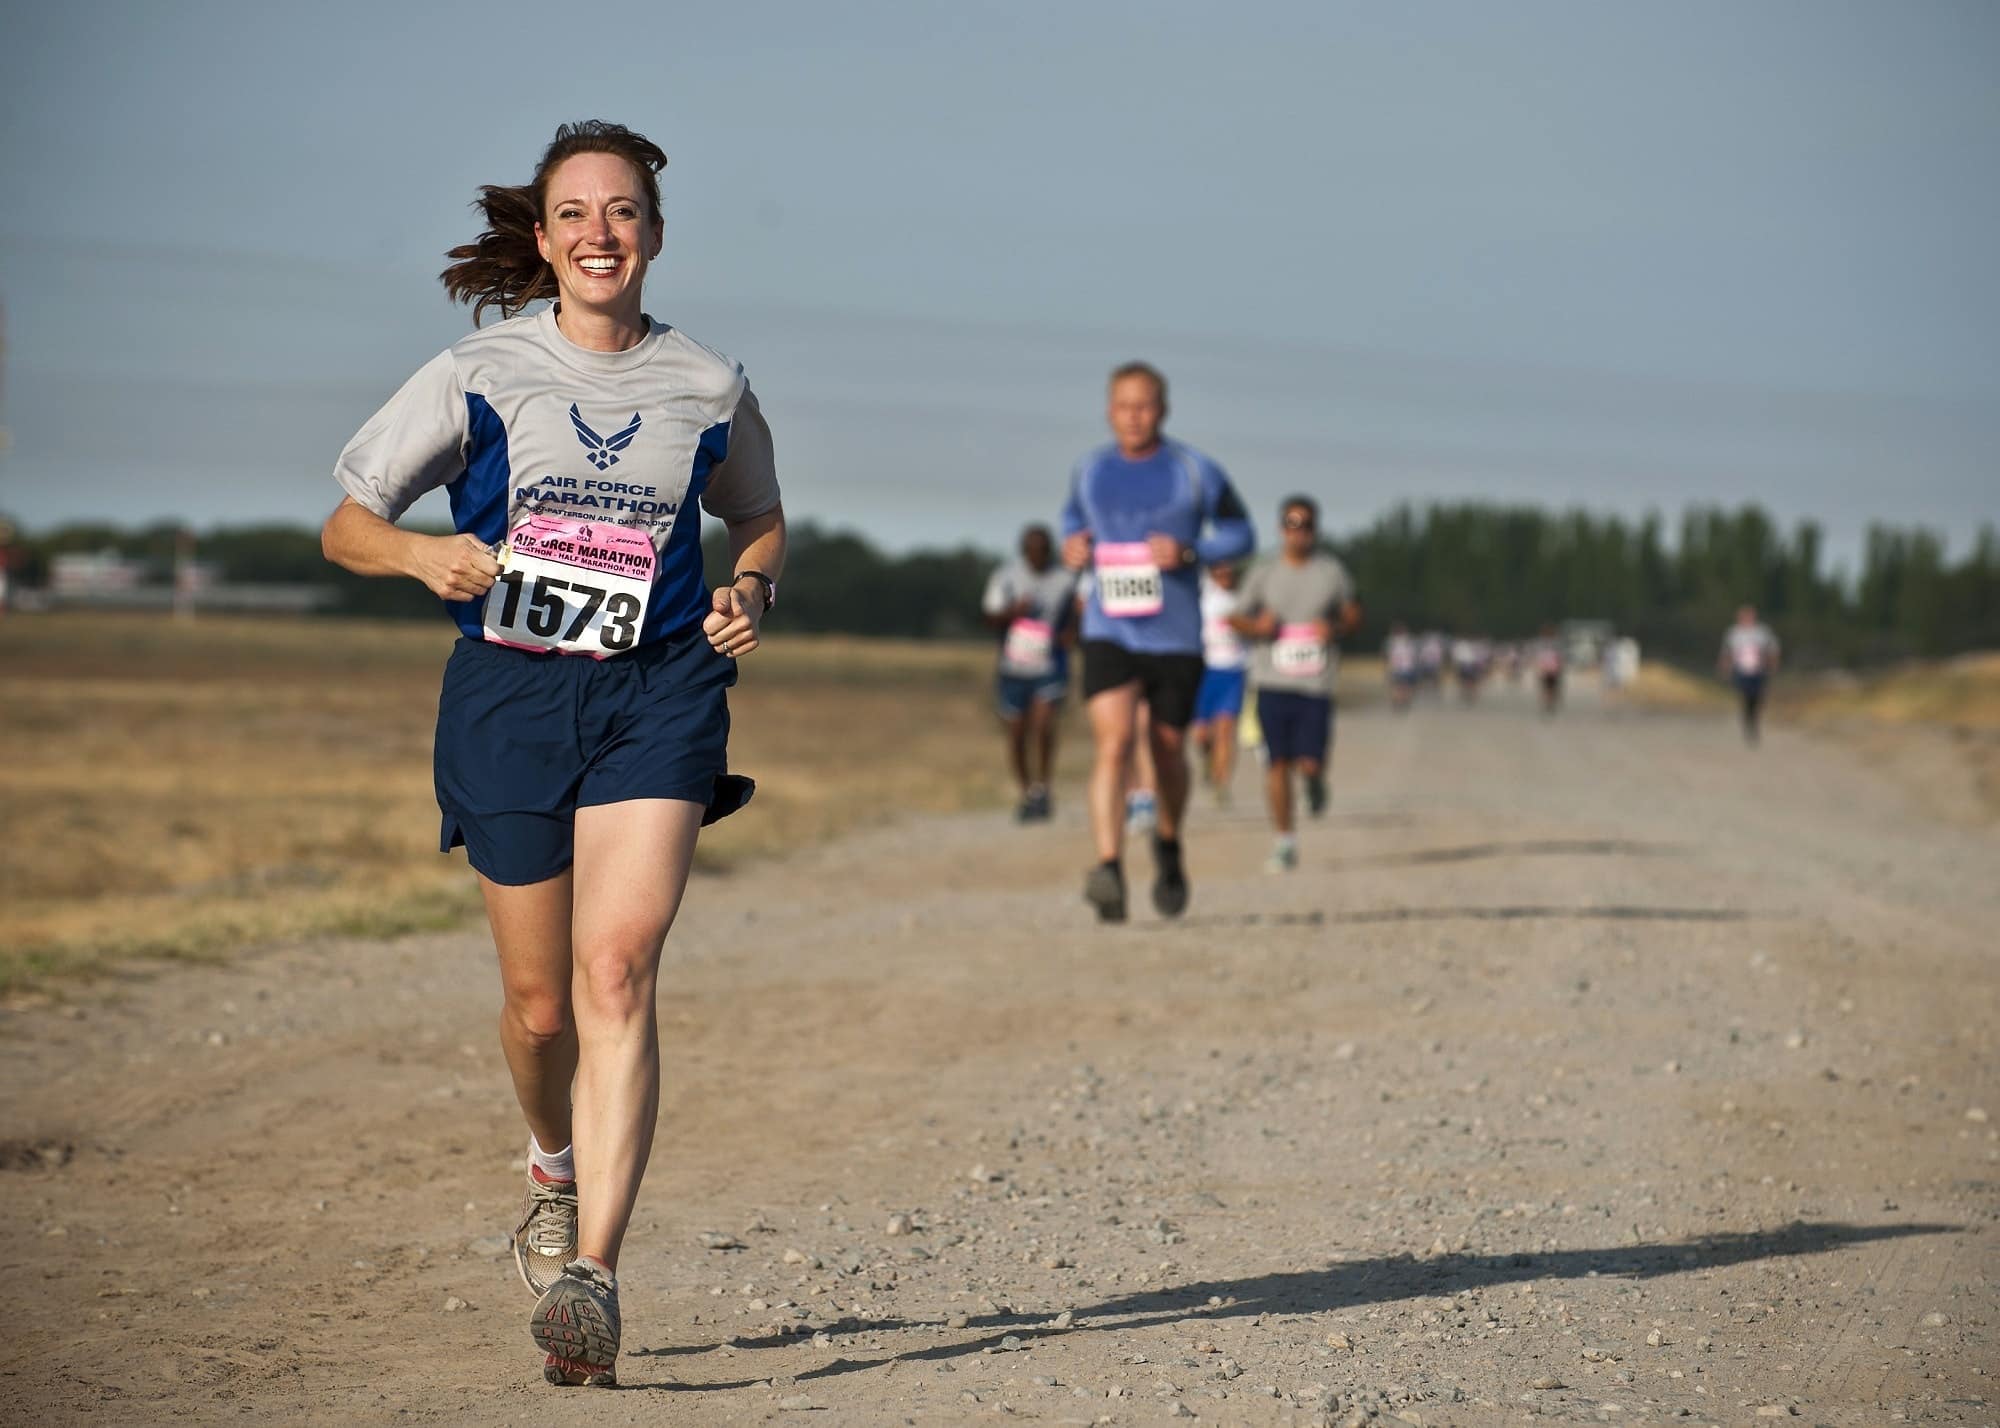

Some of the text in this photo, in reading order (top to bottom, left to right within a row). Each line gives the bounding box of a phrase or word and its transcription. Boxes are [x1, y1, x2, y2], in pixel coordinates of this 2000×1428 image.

[516, 487, 677, 515] MARATHON
[540, 475, 657, 497] AIR FORCE
[513, 533, 653, 569] AIR ORCE MARATHON
[513, 545, 553, 557] MATHON
[558, 553, 579, 562] HALF
[580, 557, 626, 573] MARATHON
[632, 568, 647, 577] 10K
[500, 569, 642, 650] 1573
